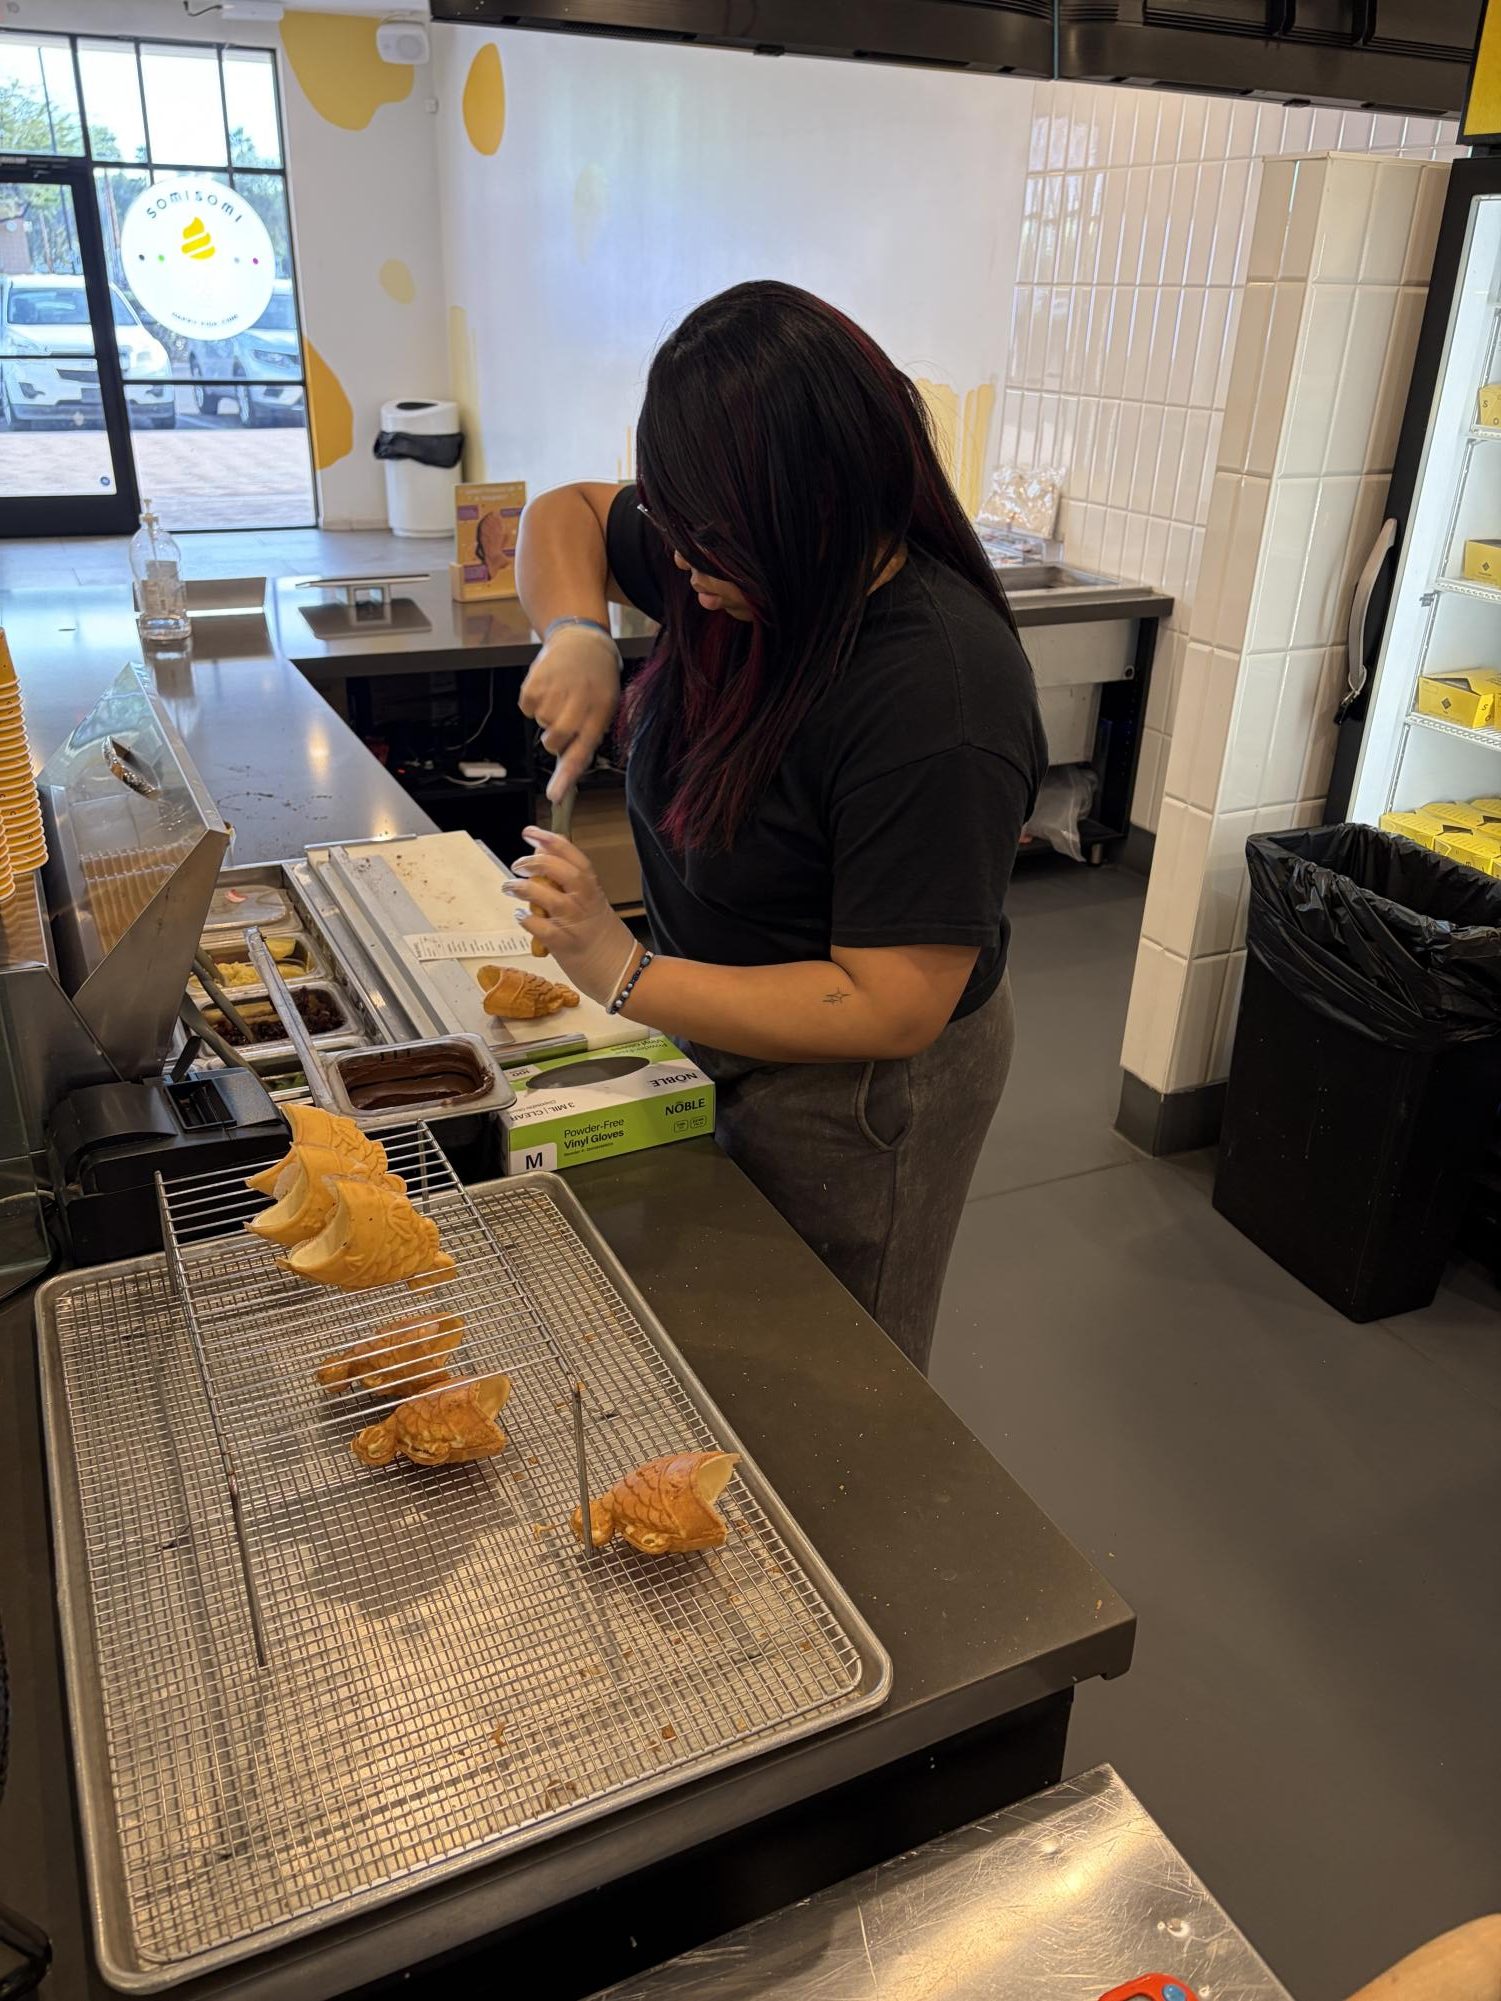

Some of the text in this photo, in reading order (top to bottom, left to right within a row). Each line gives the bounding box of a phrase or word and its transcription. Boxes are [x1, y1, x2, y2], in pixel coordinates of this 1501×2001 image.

[665, 1098, 706, 1116] NOBLE
[564, 1119, 625, 1139] Powder-Free
[564, 1130, 625, 1149] Vinyl Gloves
[526, 1151, 543, 1170] M
